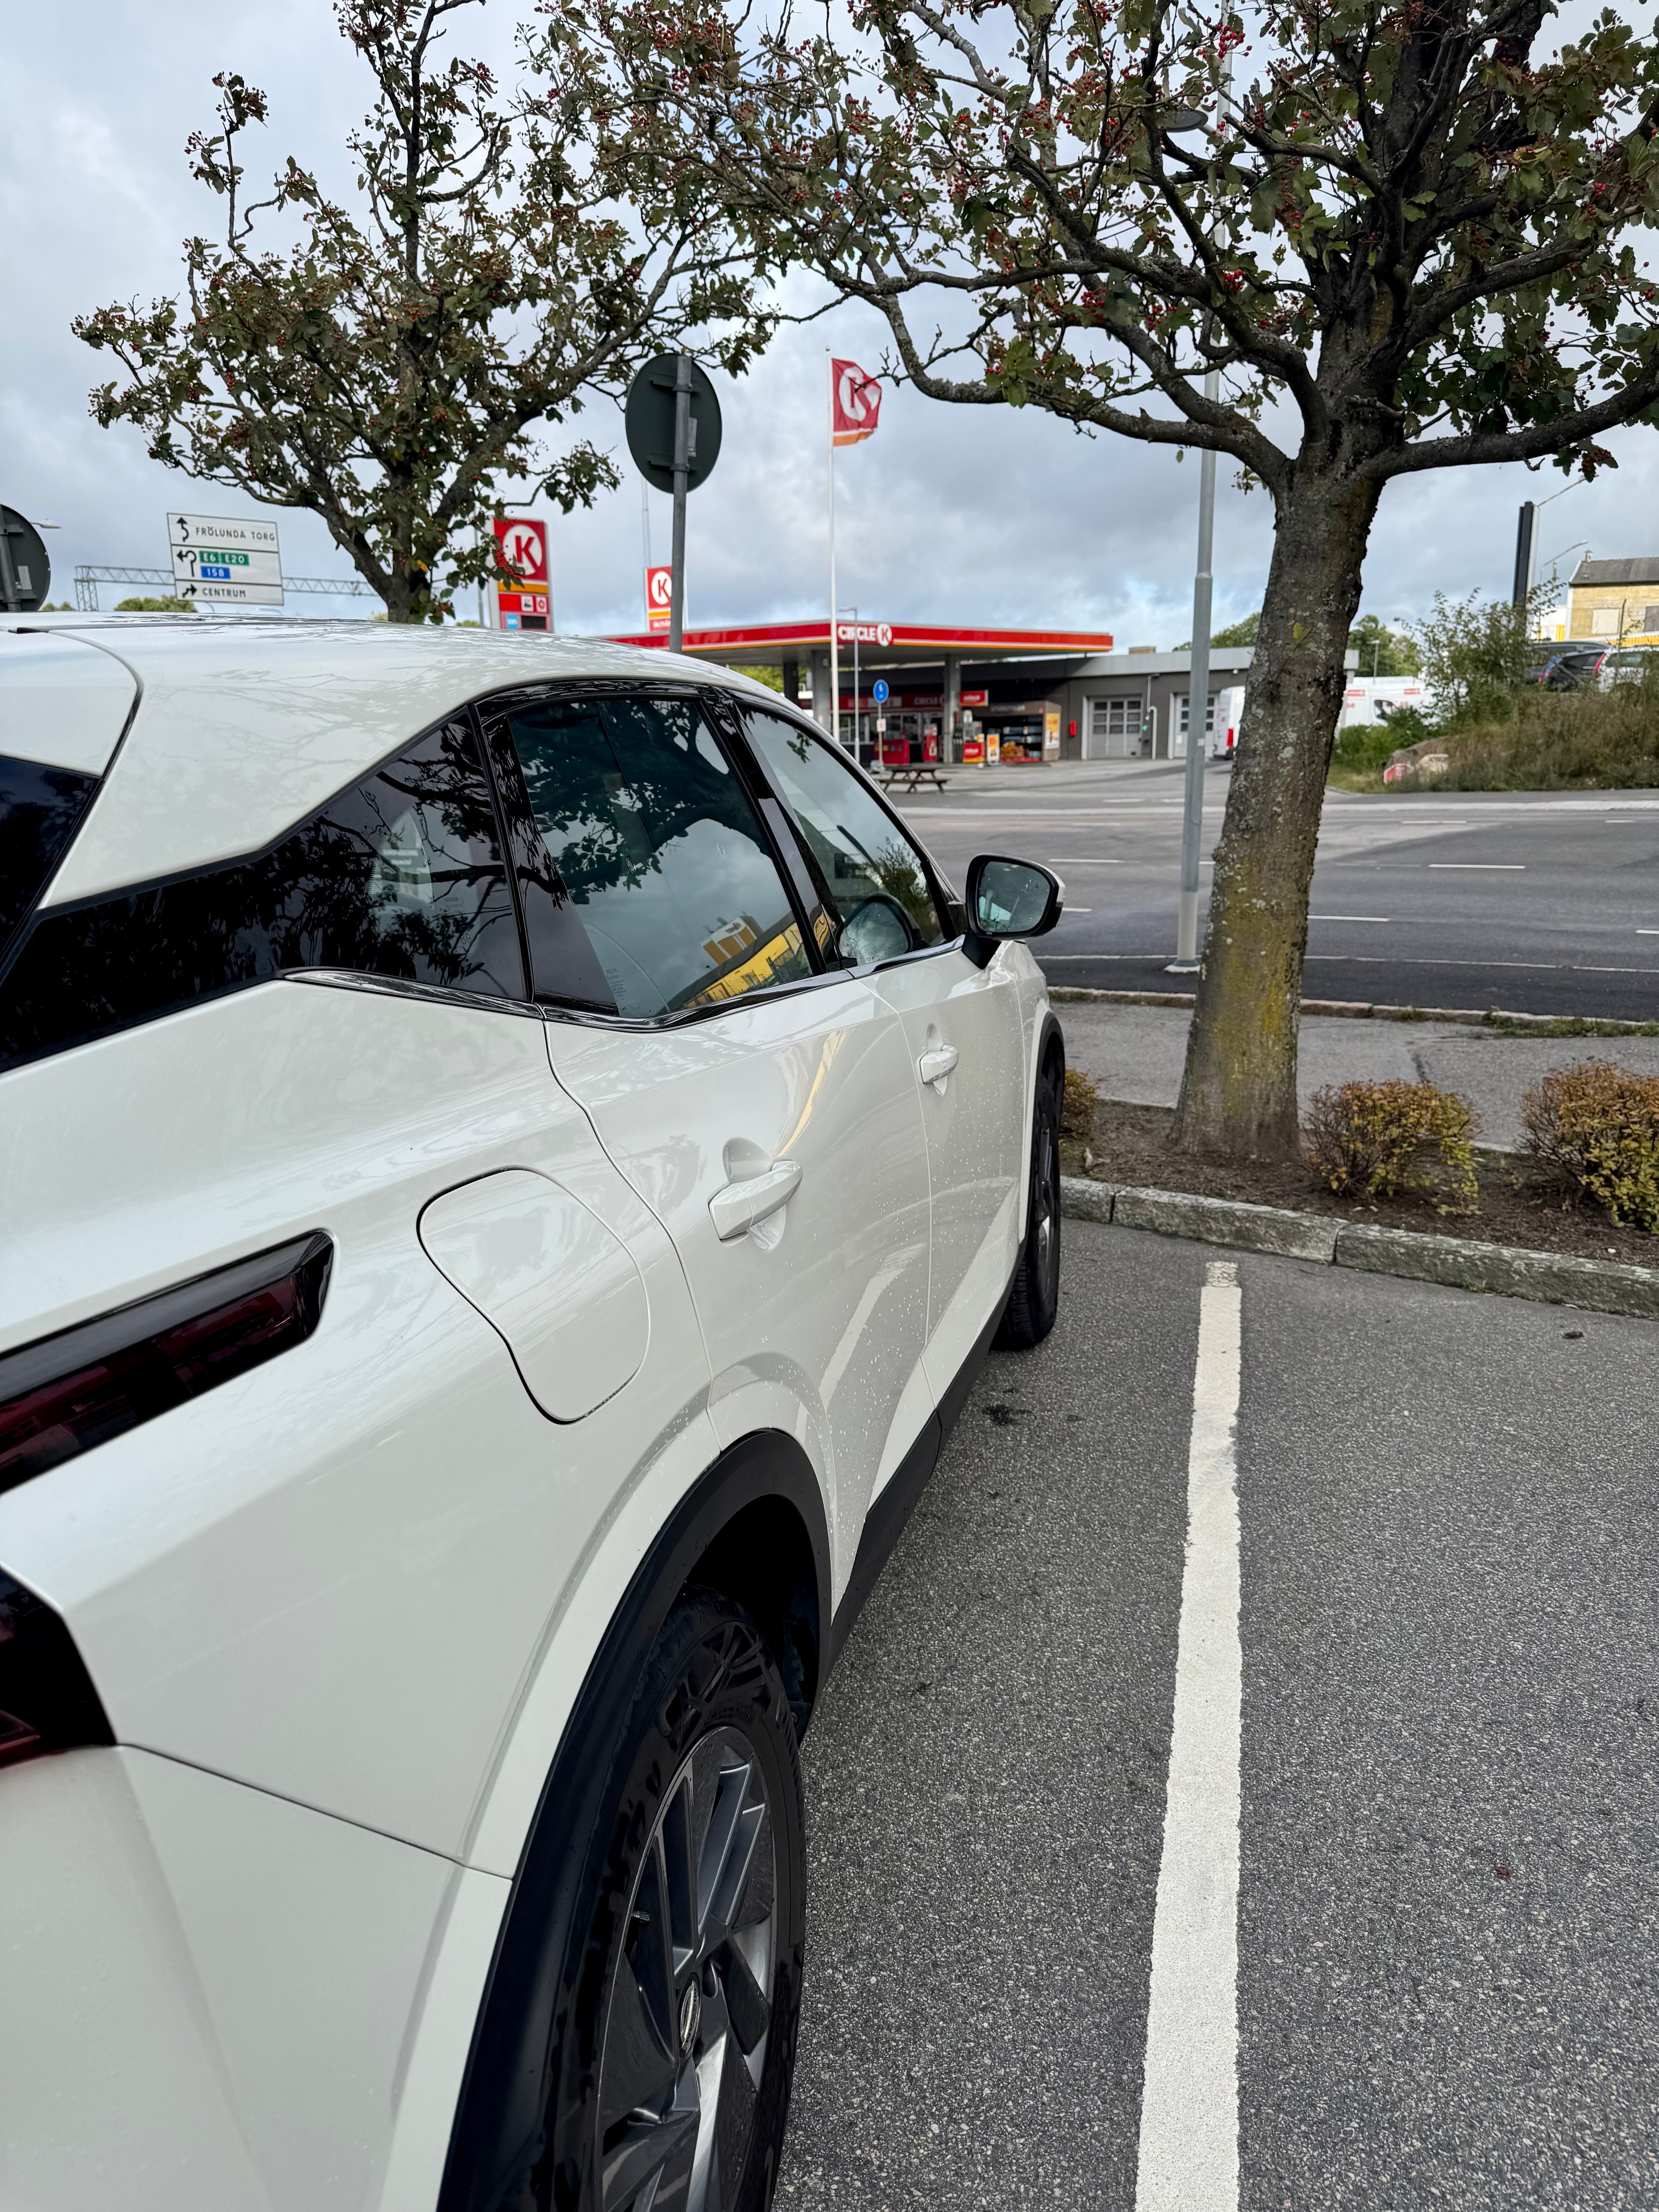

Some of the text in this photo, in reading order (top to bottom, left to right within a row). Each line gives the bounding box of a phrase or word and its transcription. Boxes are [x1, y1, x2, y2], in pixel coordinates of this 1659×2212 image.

[196, 526, 275, 541] FRÖLUNDA TORG
[203, 553, 245, 564] E6 E20
[207, 567, 225, 577] 158
[202, 587, 246, 597] CENTRUM
[838, 625, 876, 641] CIRCLE
